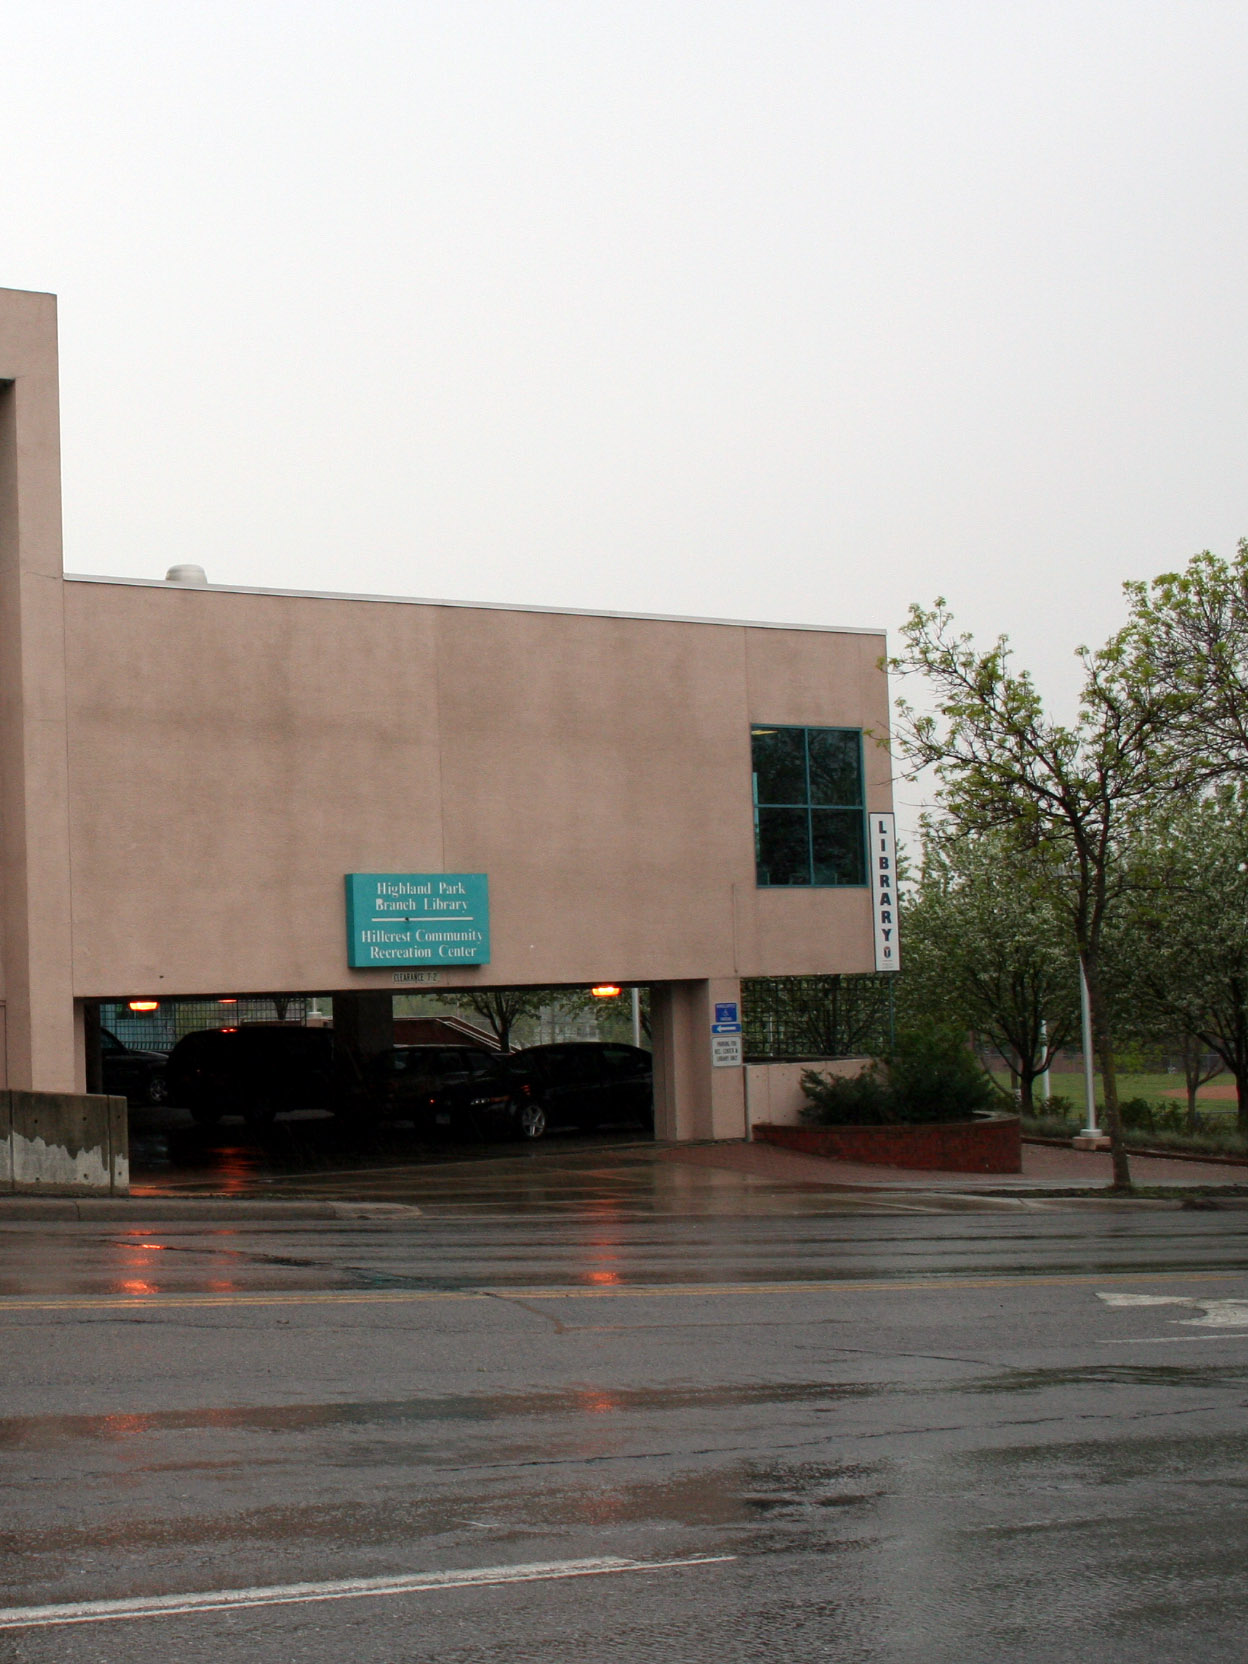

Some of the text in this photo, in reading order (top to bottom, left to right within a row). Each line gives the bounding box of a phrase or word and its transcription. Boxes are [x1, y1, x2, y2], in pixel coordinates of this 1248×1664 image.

[878, 820, 892, 942] LIBRARY
[377, 882, 466, 897] Highland Park
[375, 898, 468, 912] Branch Library
[361, 929, 482, 944] Hillcrest Community
[370, 945, 477, 959] Recreation Center
[393, 973, 424, 982] CLEARANCE
